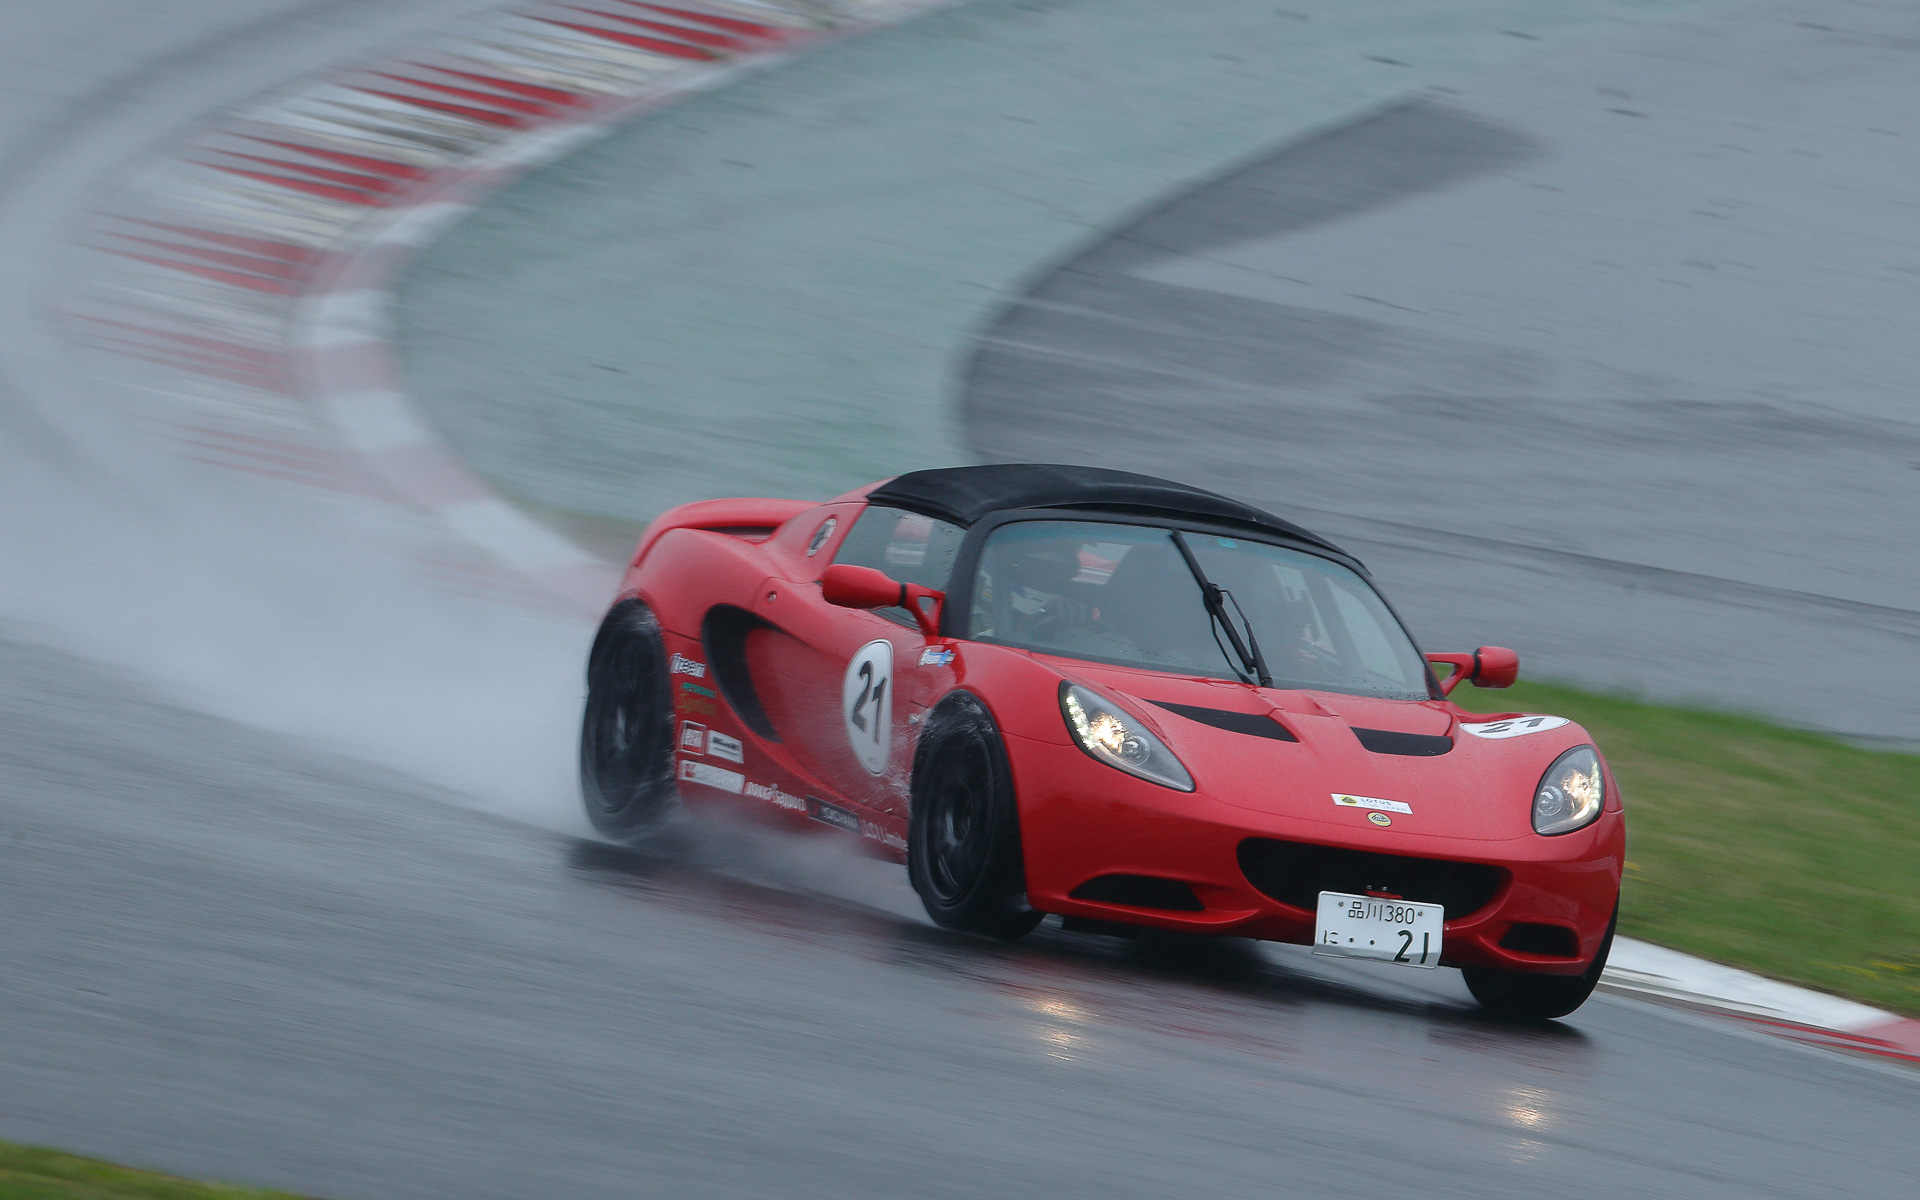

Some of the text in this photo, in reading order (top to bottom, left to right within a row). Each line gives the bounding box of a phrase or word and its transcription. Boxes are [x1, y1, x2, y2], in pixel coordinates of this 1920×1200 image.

[852, 660, 888, 745] 21
[1478, 717, 1546, 734] 21
[1394, 929, 1430, 965] 21
